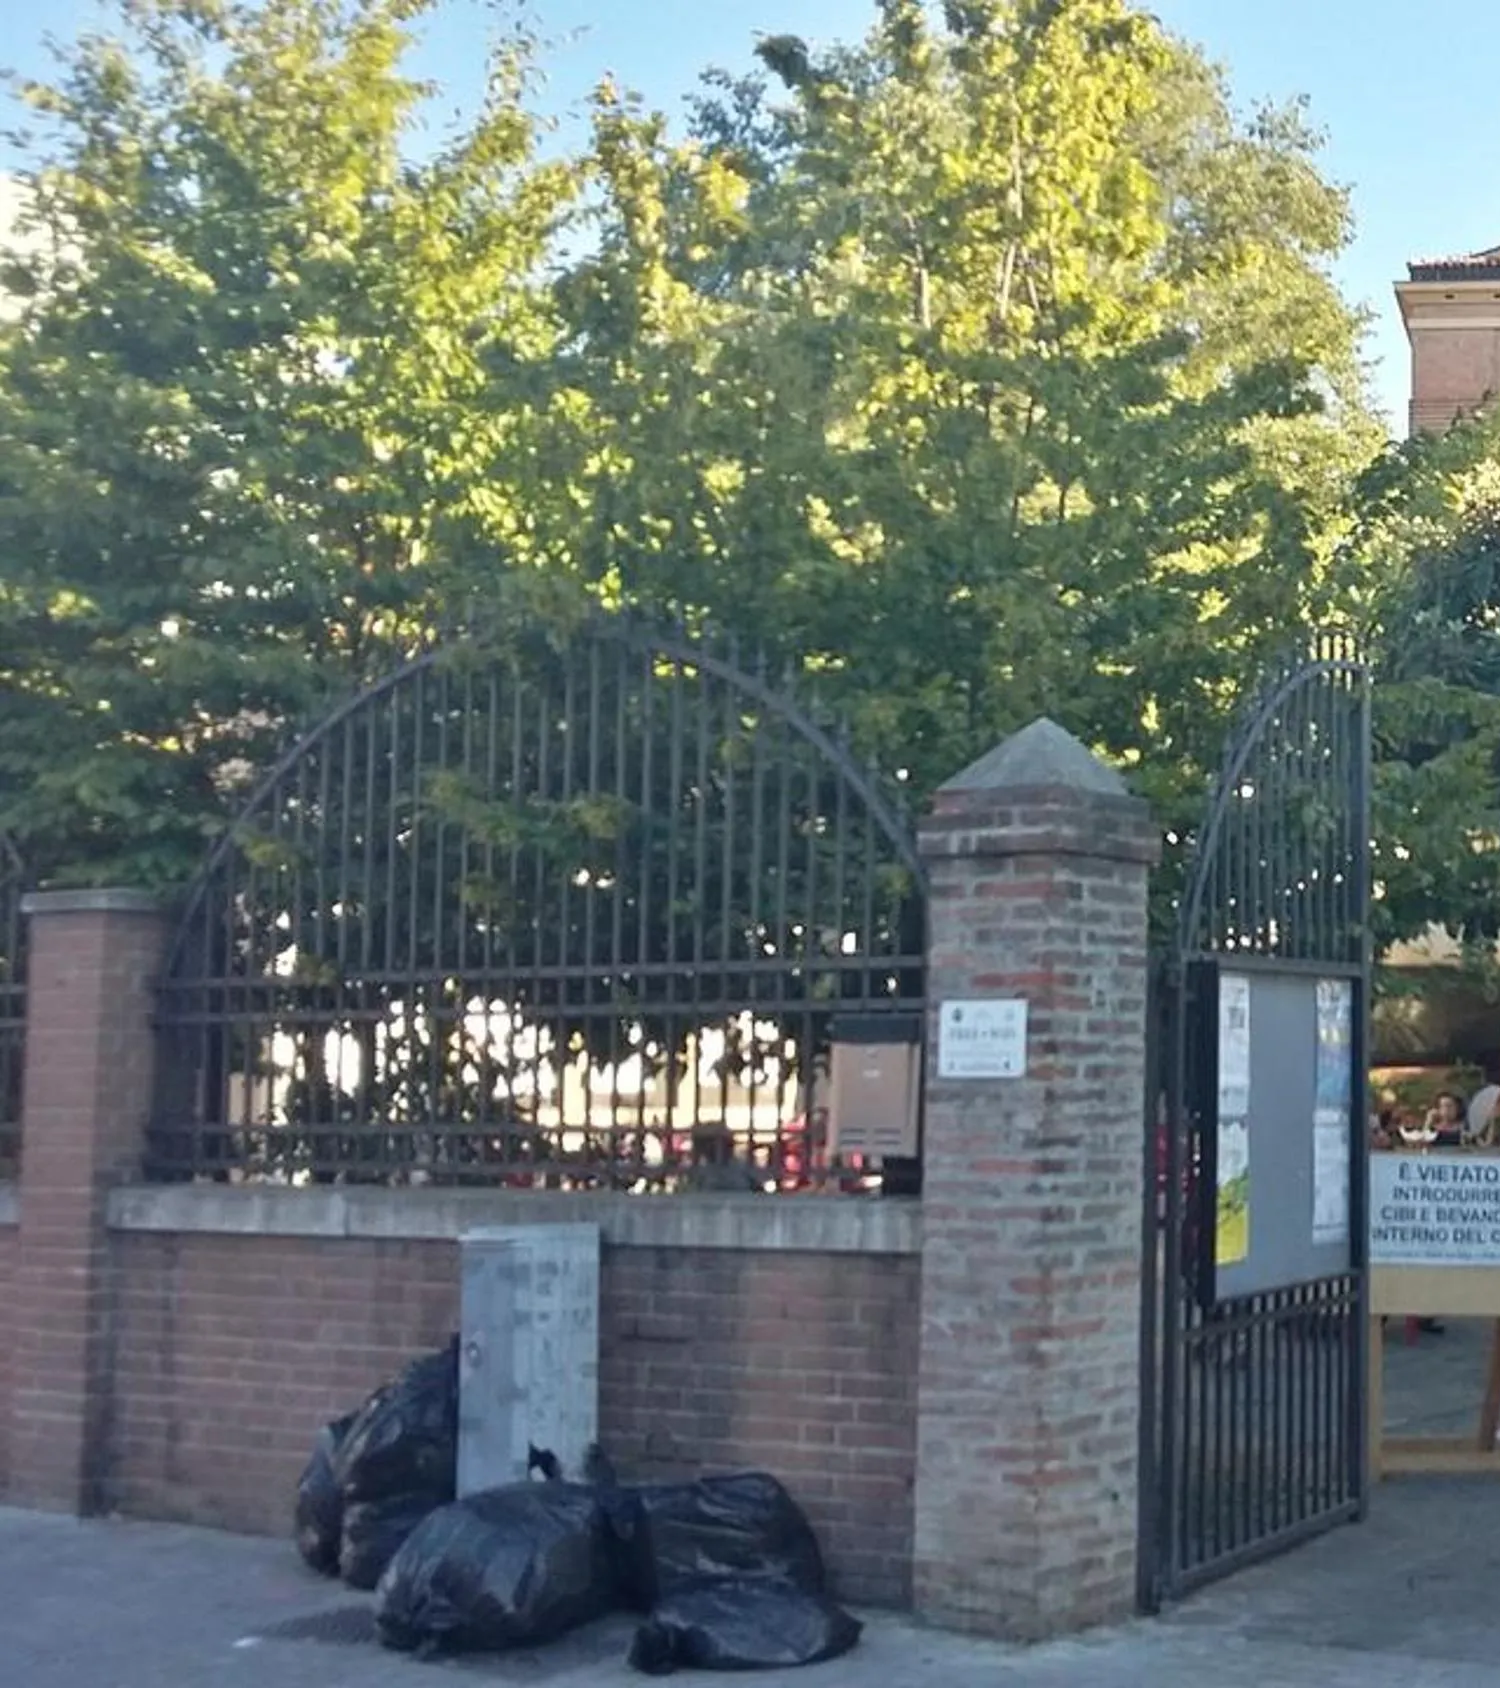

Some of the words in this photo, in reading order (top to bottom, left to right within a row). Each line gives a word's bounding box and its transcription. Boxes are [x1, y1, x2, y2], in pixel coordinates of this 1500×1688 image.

[1417, 1165, 1499, 1183] VIETATO
[1381, 1205, 1416, 1222] CIBI
[1420, 1207, 1431, 1222] E
[1453, 1228, 1486, 1245] DEL
